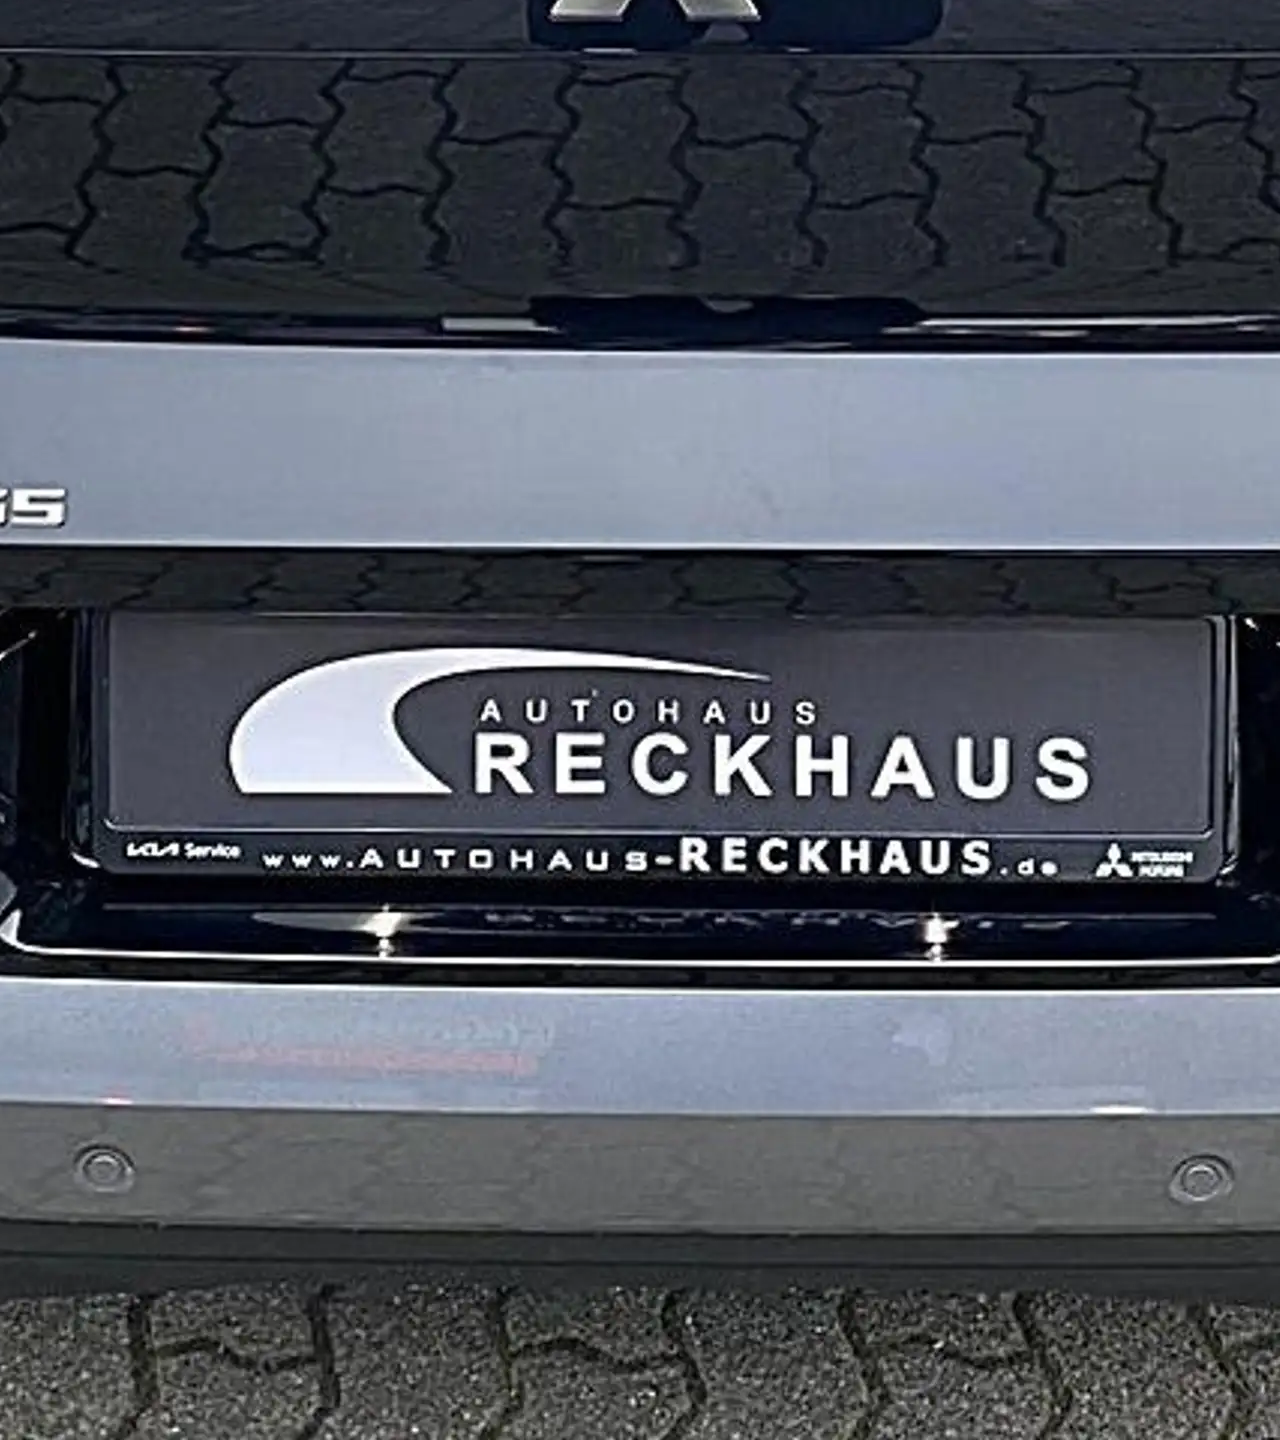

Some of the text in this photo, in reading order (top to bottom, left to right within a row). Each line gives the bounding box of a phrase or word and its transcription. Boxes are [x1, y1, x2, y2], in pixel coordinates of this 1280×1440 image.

[480, 699, 817, 726] AUTOHAUS
[475, 731, 1090, 801] RECKHAUS
[184, 842, 241, 858] Service
